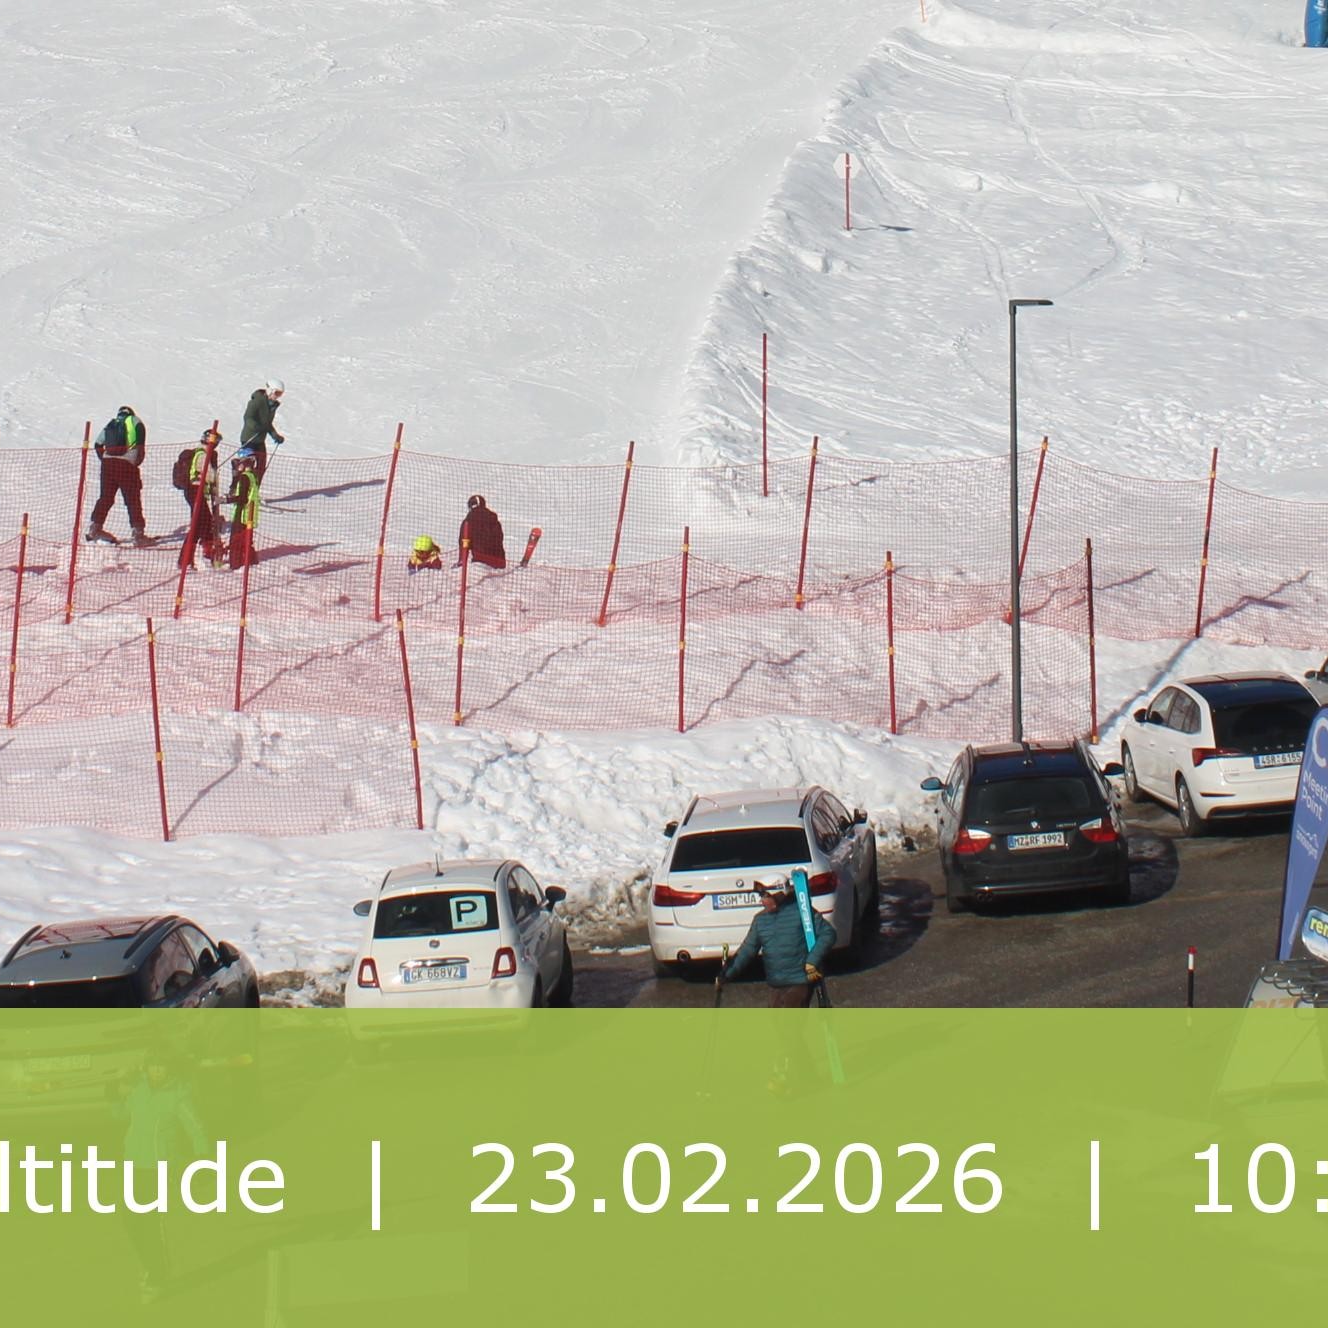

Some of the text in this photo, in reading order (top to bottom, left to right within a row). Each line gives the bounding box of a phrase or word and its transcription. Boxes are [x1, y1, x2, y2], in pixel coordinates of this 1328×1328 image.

[1301, 786, 1323, 821] Point
[1043, 833, 1062, 844] 1992
[455, 900, 478, 923] P
